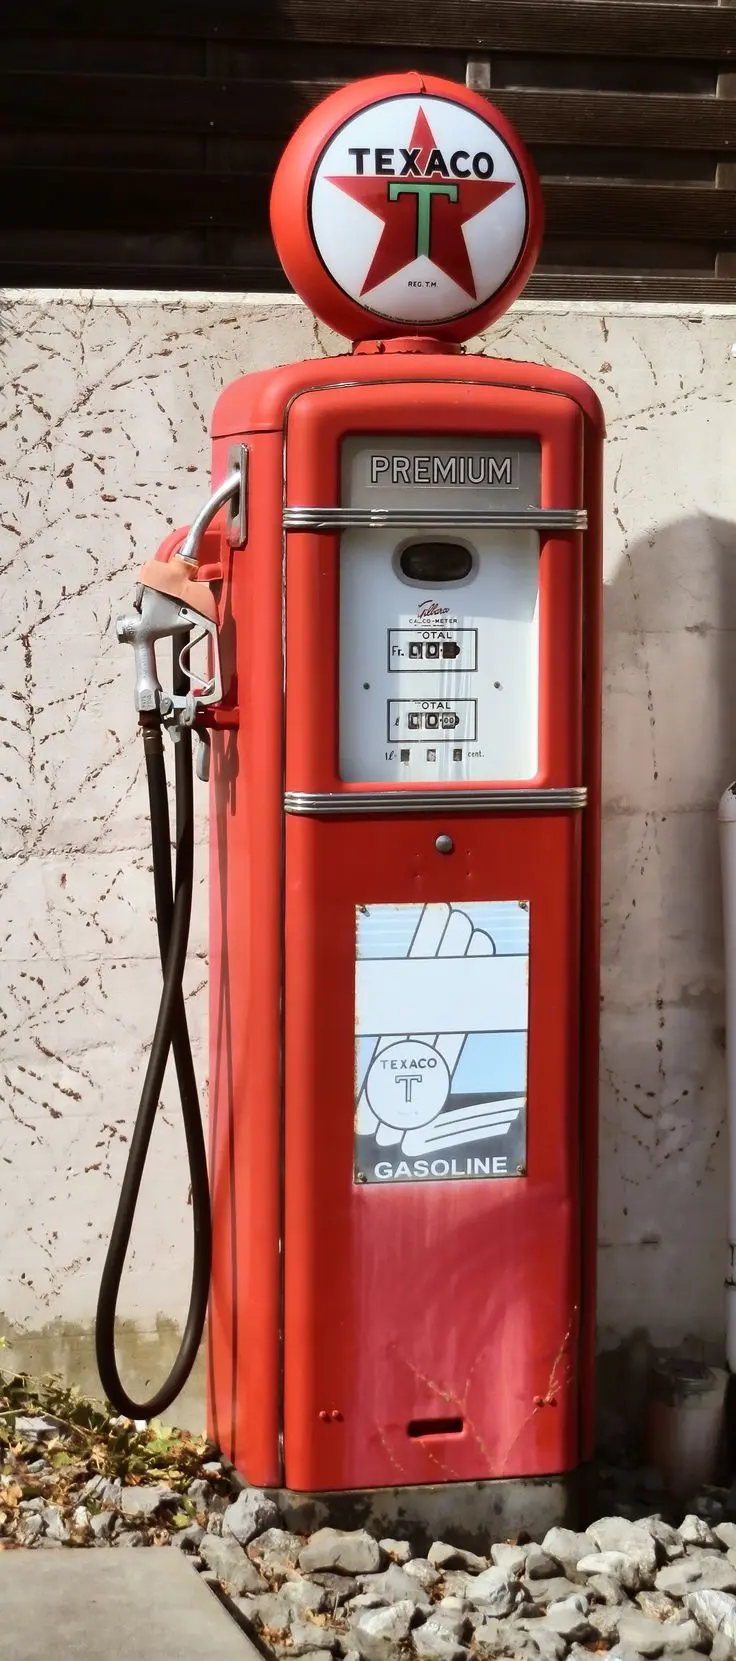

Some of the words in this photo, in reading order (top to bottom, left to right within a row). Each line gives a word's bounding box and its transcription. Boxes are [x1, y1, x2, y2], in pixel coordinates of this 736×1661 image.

[348, 147, 494, 179] TEXACO
[387, 180, 459, 258] T
[370, 455, 512, 484] PREMIUM
[415, 701, 451, 710] OTAL
[380, 1058, 438, 1070] TEXACO
[394, 1074, 423, 1103] T
[374, 1156, 508, 1179] GASOLINE
